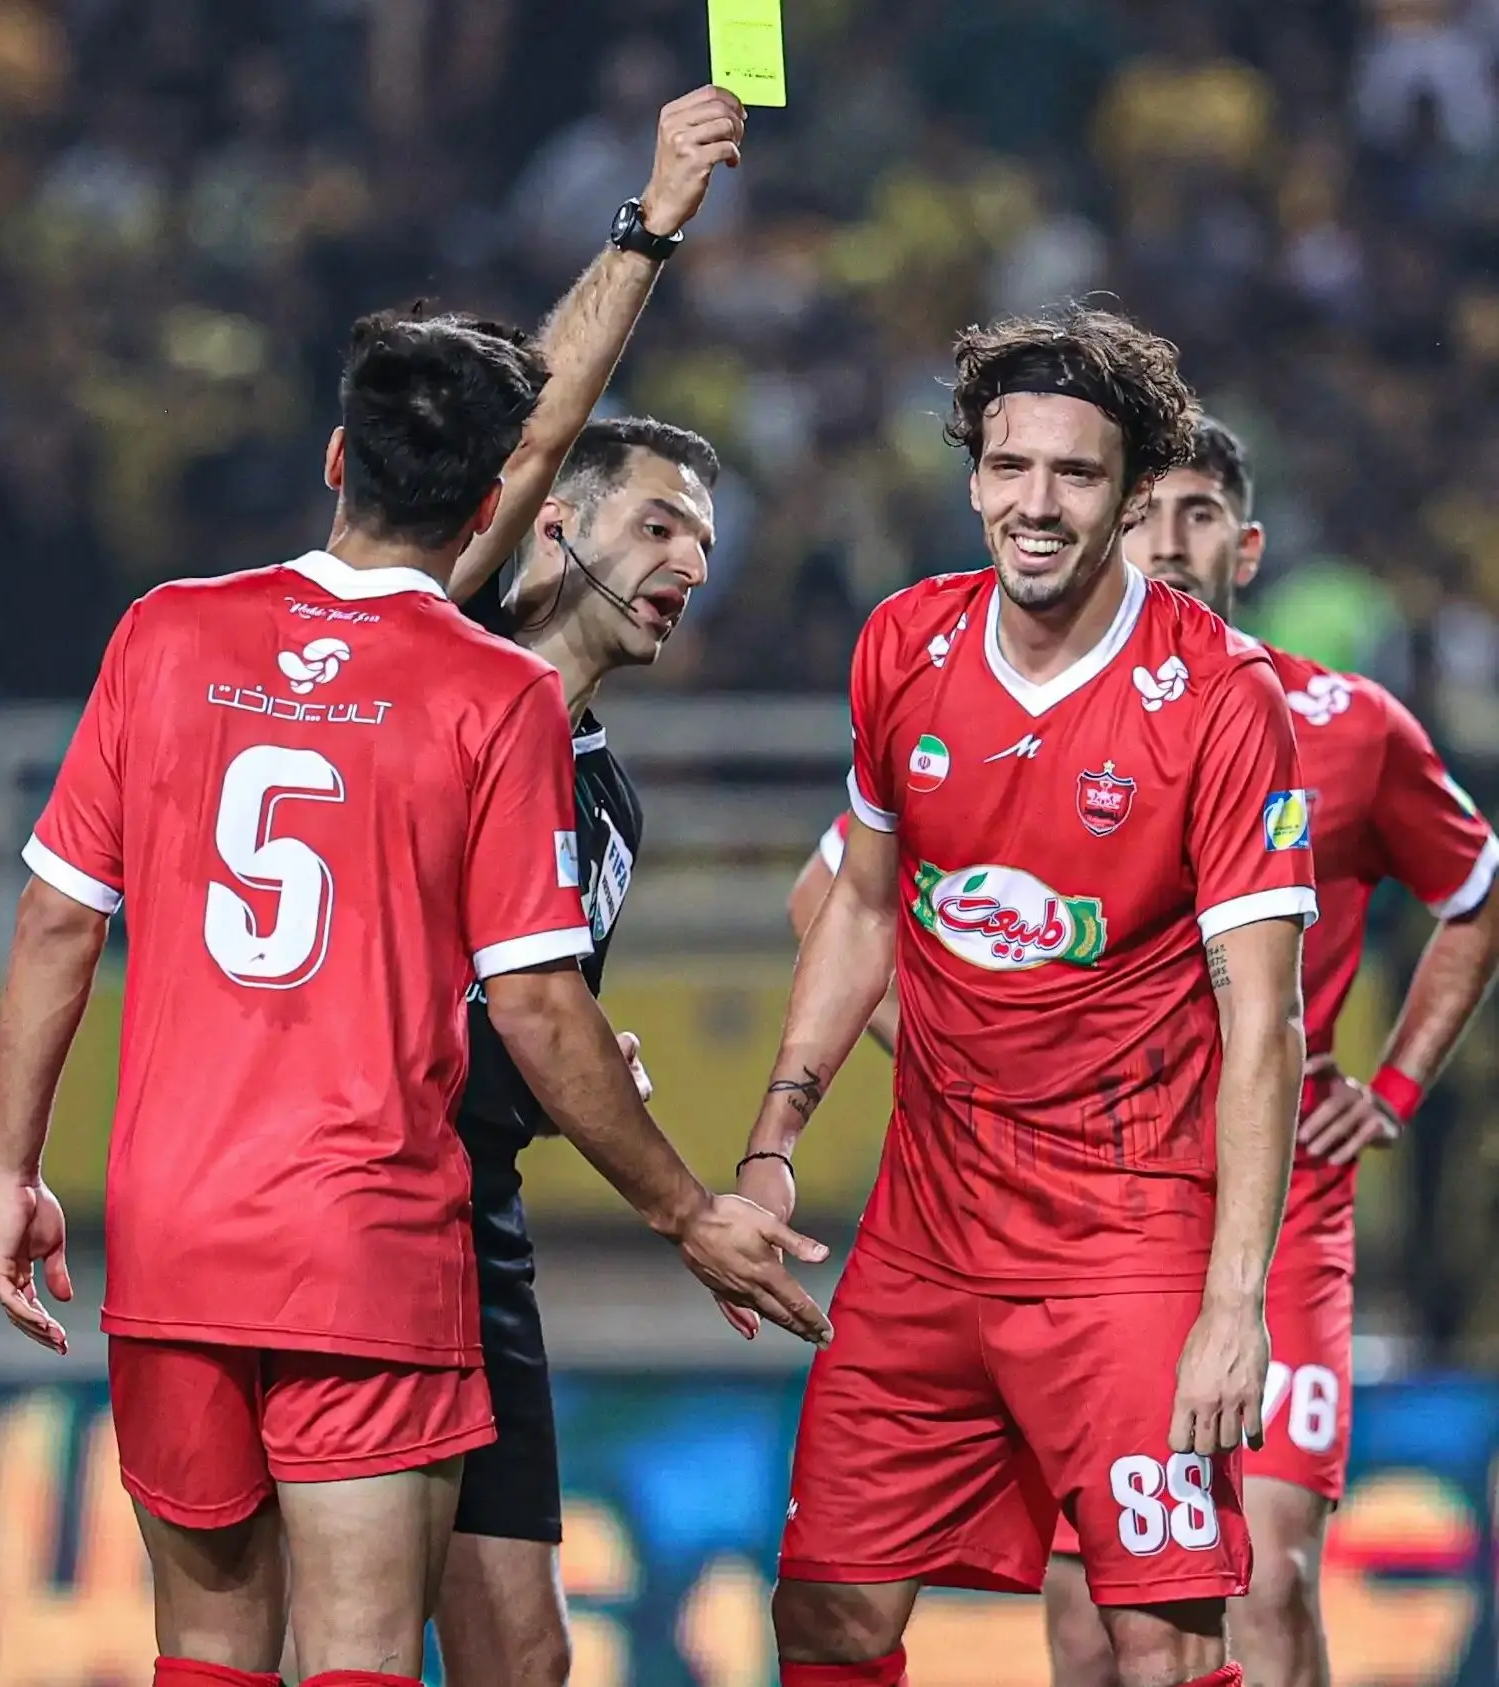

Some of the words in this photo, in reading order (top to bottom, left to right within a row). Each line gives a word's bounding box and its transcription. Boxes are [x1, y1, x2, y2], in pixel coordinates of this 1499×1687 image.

[203, 744, 345, 990] 5
[608, 841, 629, 897] FIFA
[937, 895, 1068, 963] طبیعت
[1108, 1454, 1221, 1557] 88
